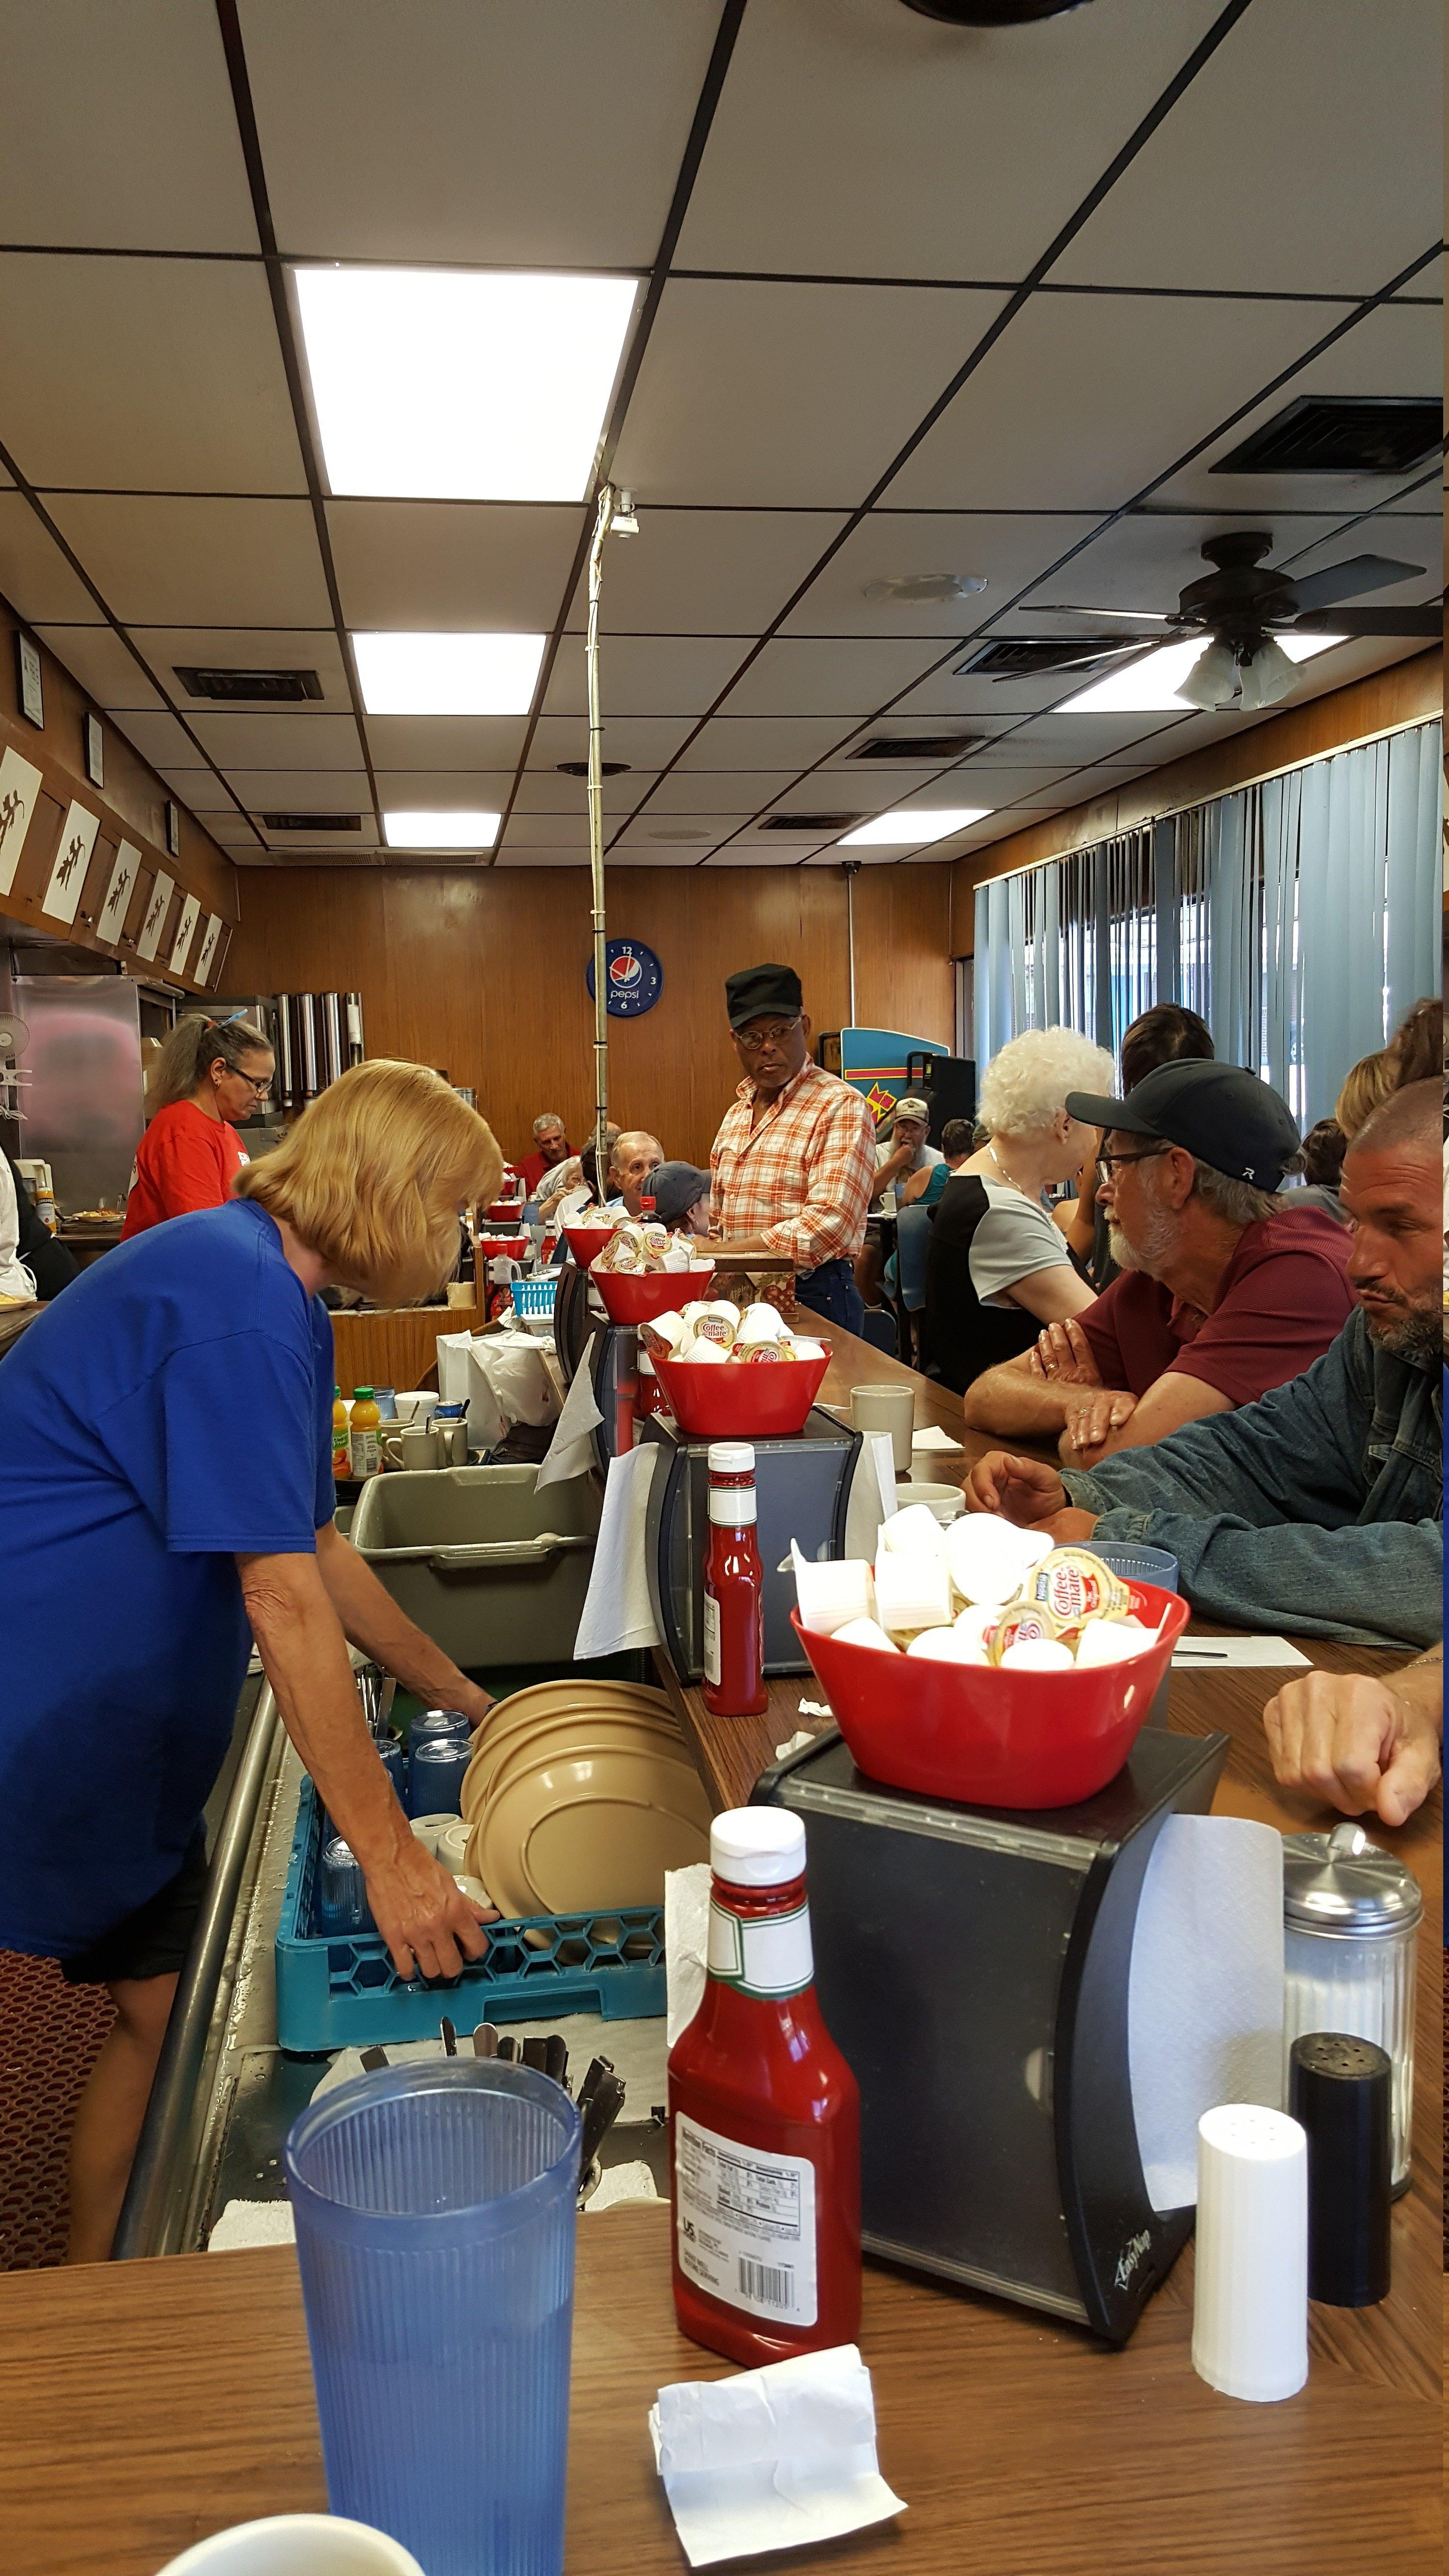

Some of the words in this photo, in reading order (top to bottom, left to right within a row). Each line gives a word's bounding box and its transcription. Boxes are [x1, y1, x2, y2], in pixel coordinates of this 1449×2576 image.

[611, 990, 639, 999] pepsi
[1054, 1570, 1072, 1615] Coffee
[1068, 1569, 1081, 1606] mate
